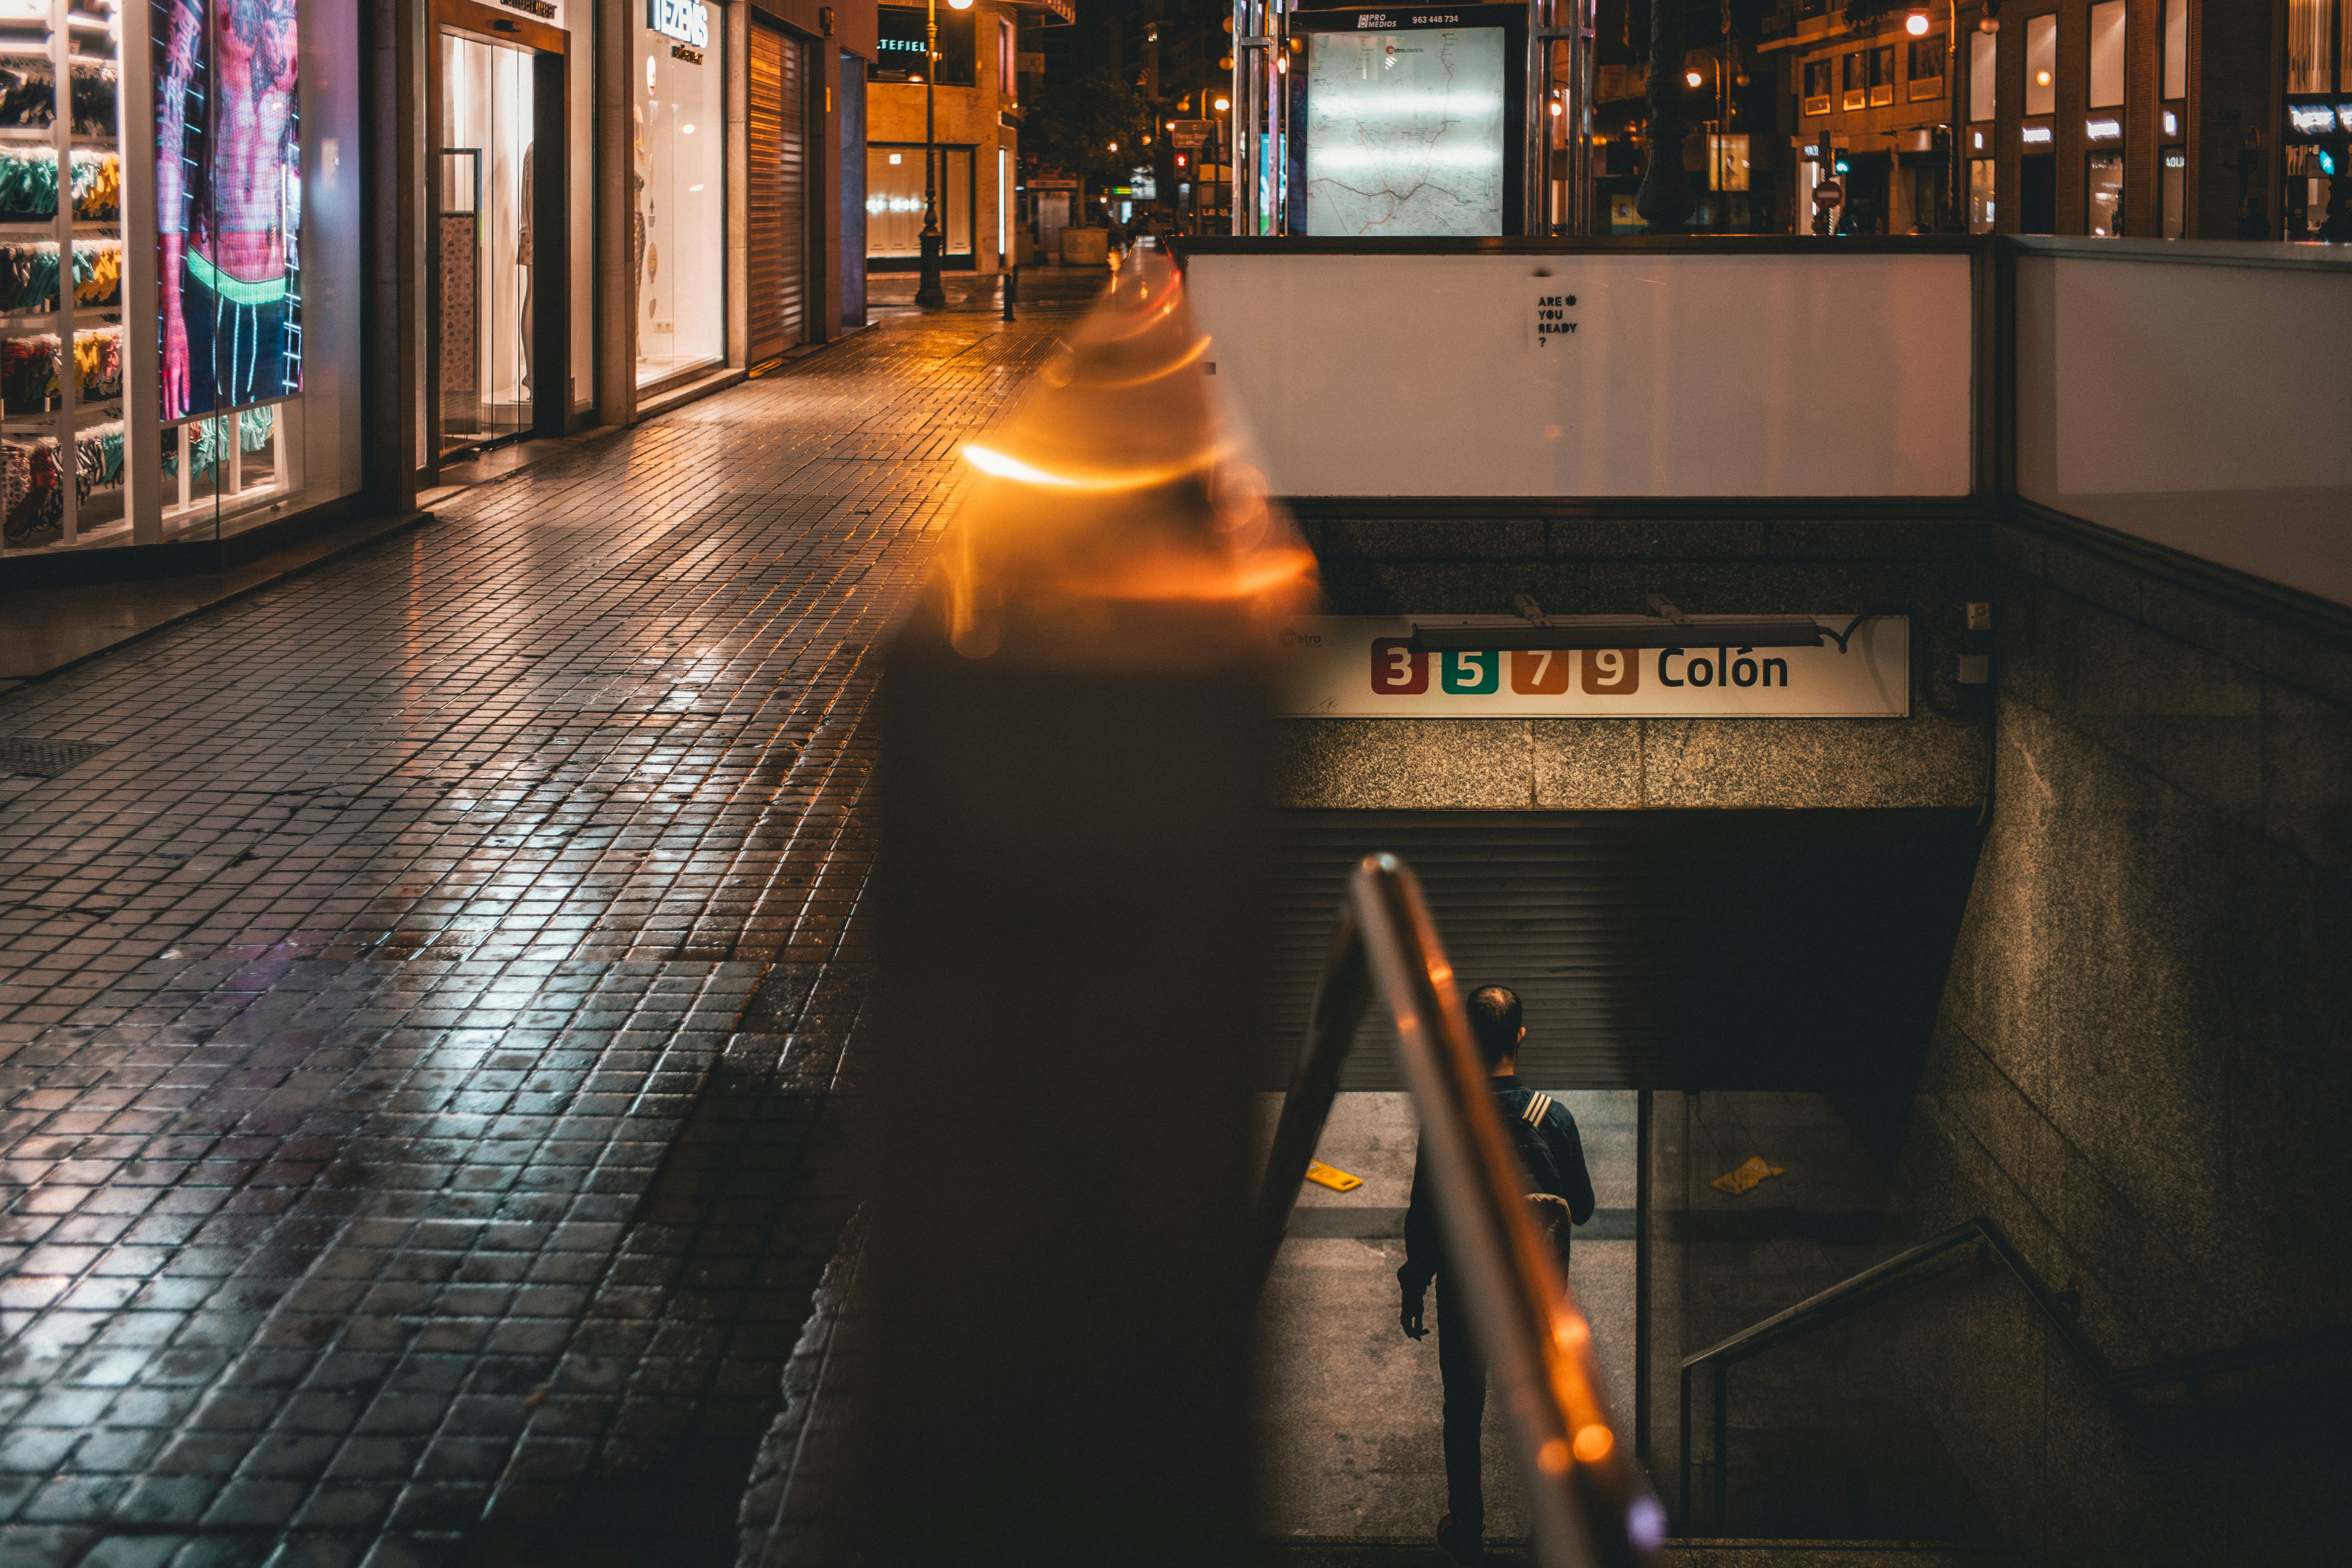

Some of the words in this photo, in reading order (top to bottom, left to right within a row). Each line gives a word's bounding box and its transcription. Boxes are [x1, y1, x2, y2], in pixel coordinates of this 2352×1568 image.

[1538, 297, 1562, 306] ARE
[1538, 310, 1562, 320] YOU
[1538, 337, 1546, 347] ?
[1387, 647, 1412, 686] 3
[1457, 652, 1483, 687] 5
[1527, 651, 1552, 685] 7
[1596, 649, 1624, 686] 9
[1658, 647, 1788, 687] Colón
